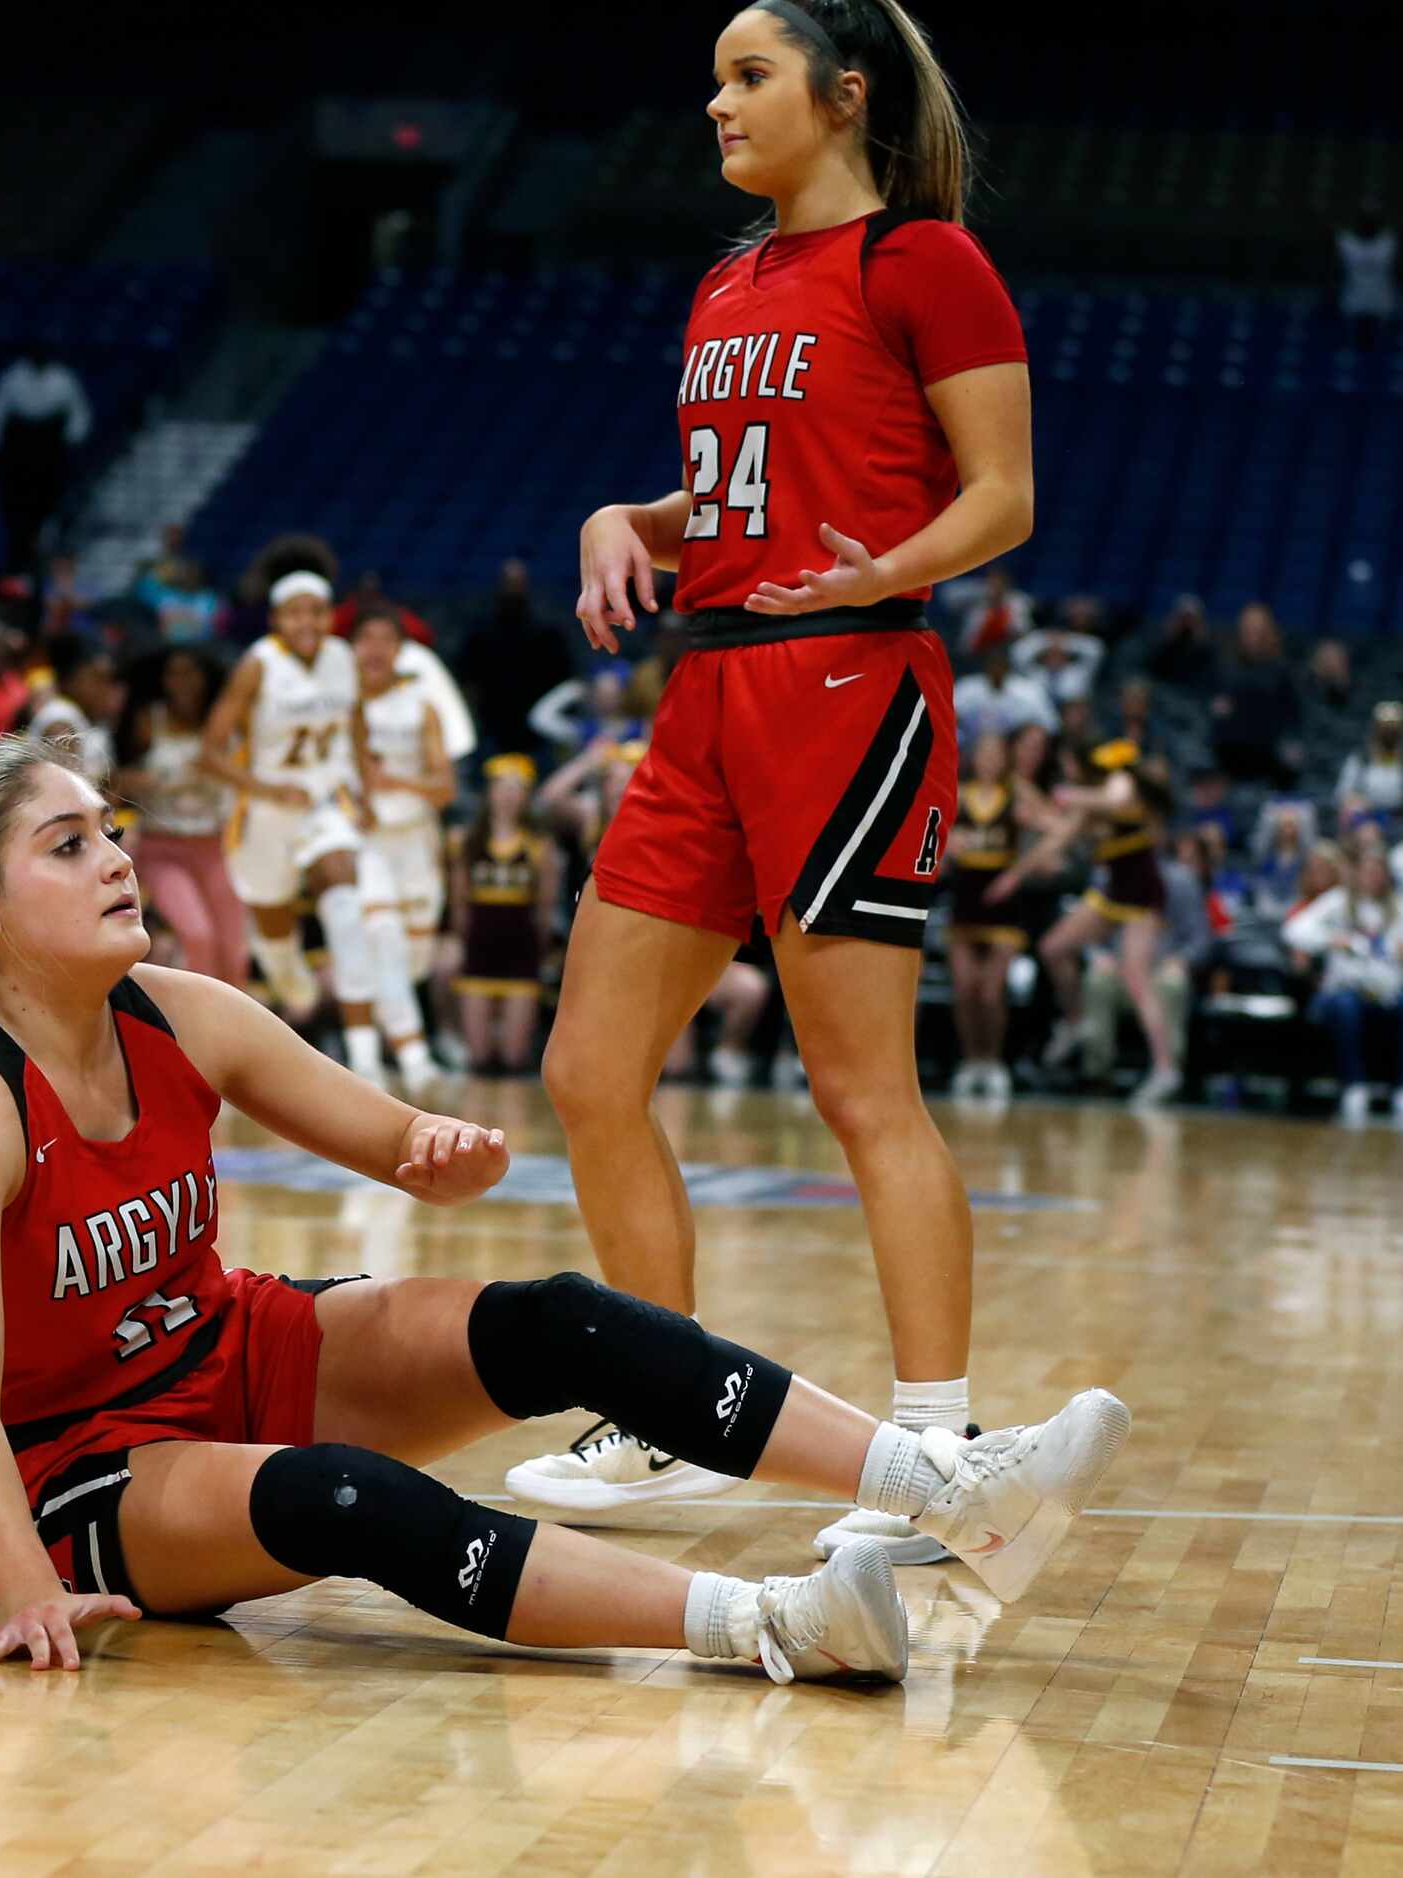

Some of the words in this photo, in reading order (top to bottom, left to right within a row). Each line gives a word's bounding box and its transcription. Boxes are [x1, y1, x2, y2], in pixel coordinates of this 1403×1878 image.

[677, 331, 817, 408] ARGYLE
[684, 422, 768, 538] 24
[914, 806, 941, 875] A
